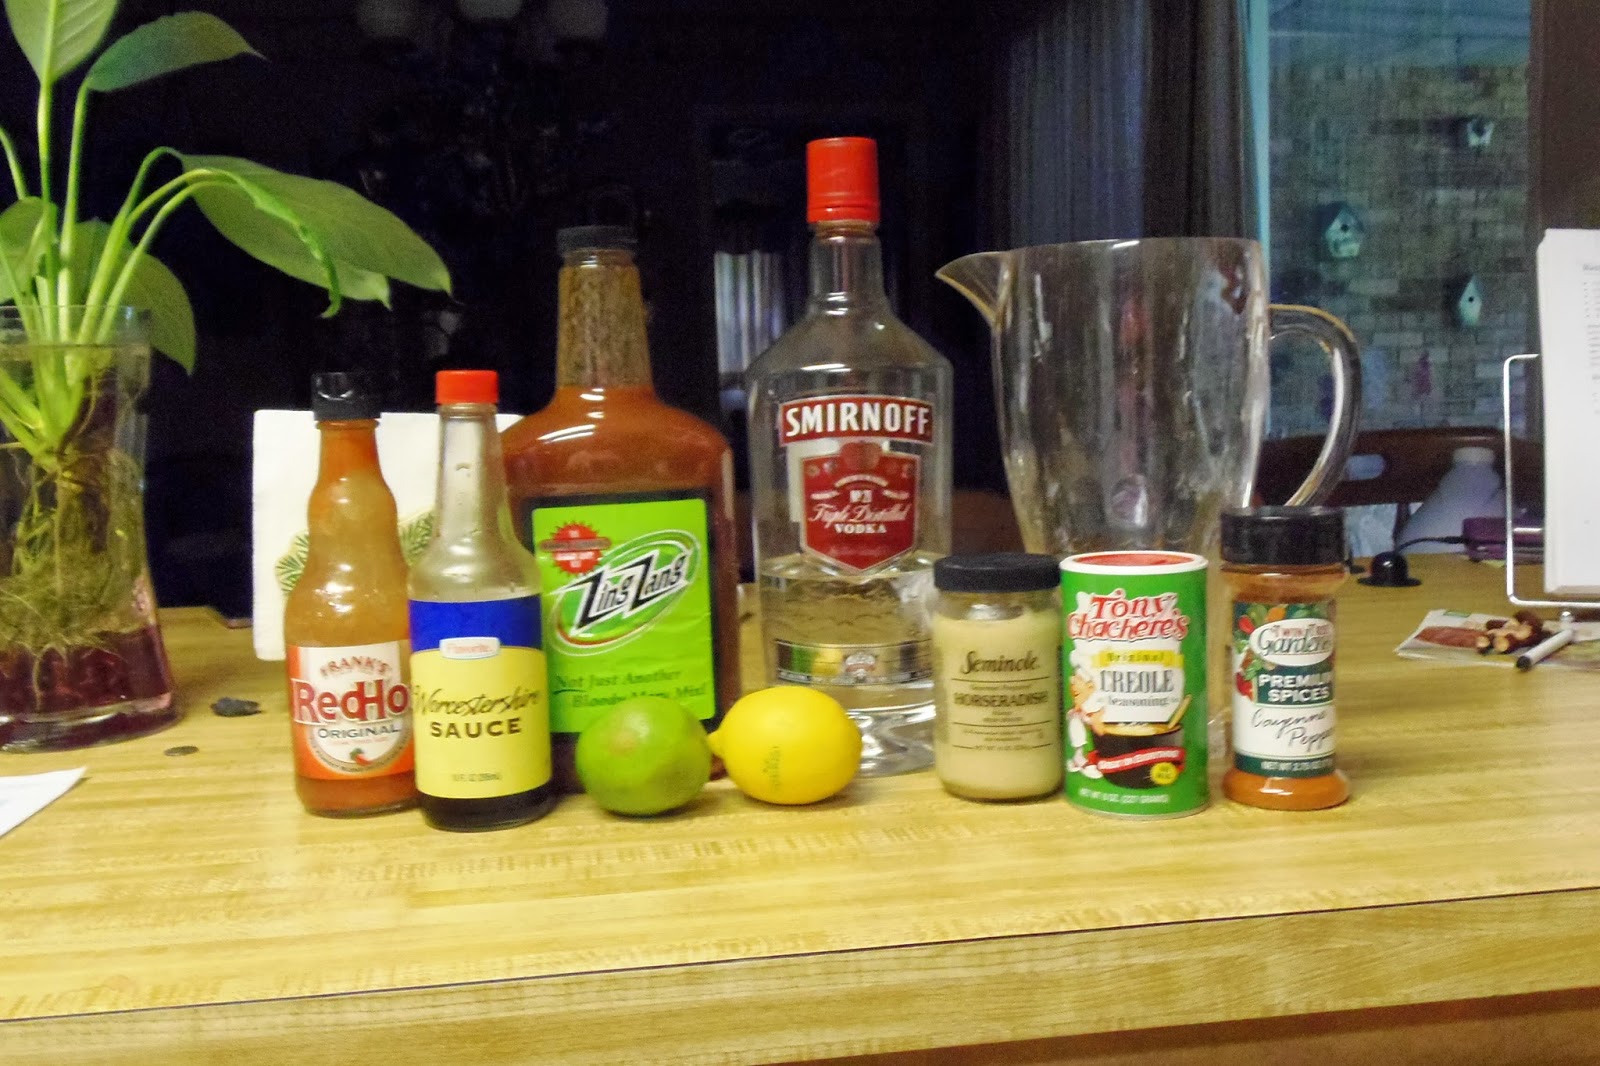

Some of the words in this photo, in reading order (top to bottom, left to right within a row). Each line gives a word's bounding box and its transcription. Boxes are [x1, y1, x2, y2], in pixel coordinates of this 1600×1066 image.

[786, 402, 930, 437] SMIRNOFF
[834, 523, 887, 534] VODKA
[1090, 588, 1177, 619] Tony
[1099, 669, 1175, 694] CREOLE
[291, 679, 409, 724] RedHo
[1268, 688, 1330, 703] SPICES
[317, 724, 401, 739] ORIGINAL
[430, 717, 523, 739] SAUCE
